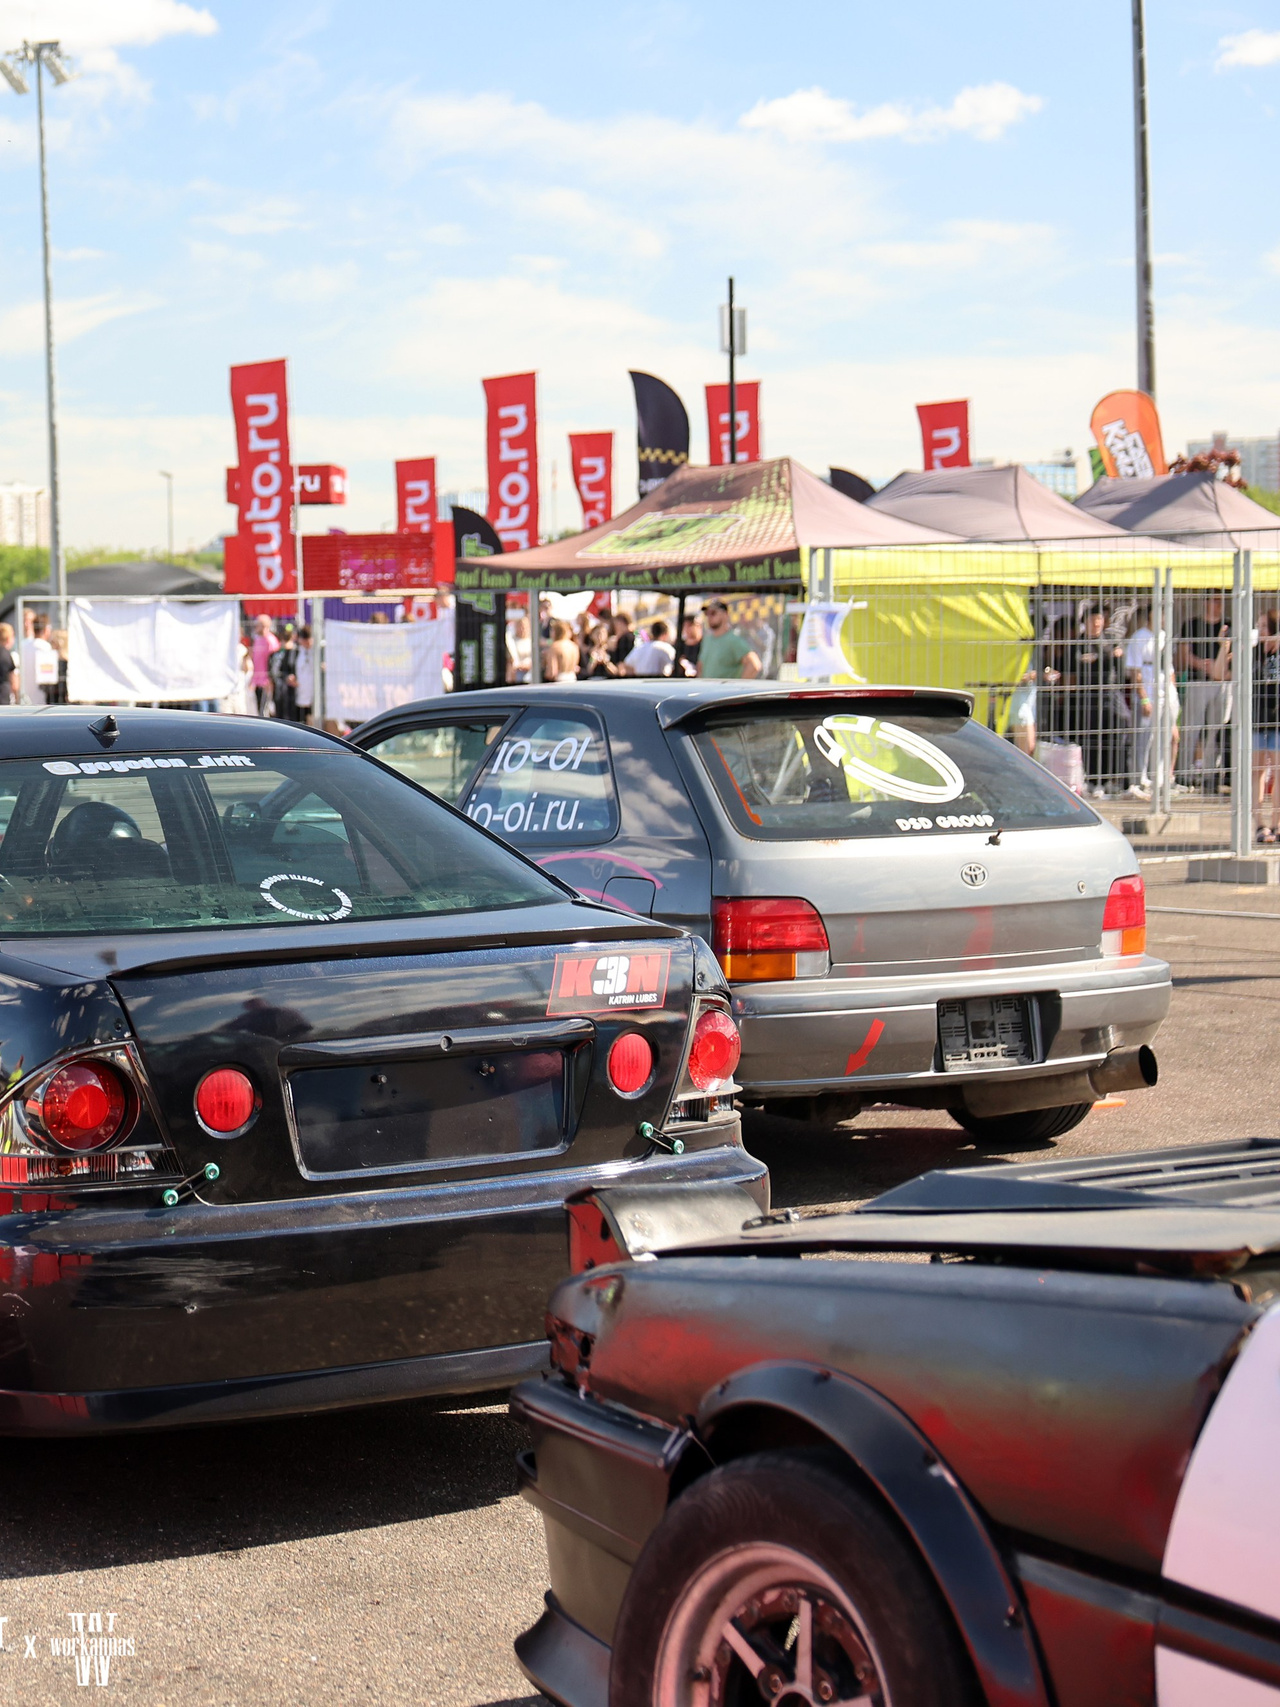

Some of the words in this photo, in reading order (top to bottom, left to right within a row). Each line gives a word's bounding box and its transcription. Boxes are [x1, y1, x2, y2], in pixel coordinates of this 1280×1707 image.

[244, 392, 284, 591] auto.ru
[494, 403, 530, 550] uto.ru
[895, 816, 934, 832] DSD
[935, 814, 995, 829] GROUP
[558, 954, 662, 998] K3N
[608, 994, 635, 1006] KATRIN
[635, 993, 658, 1004] LUBES
